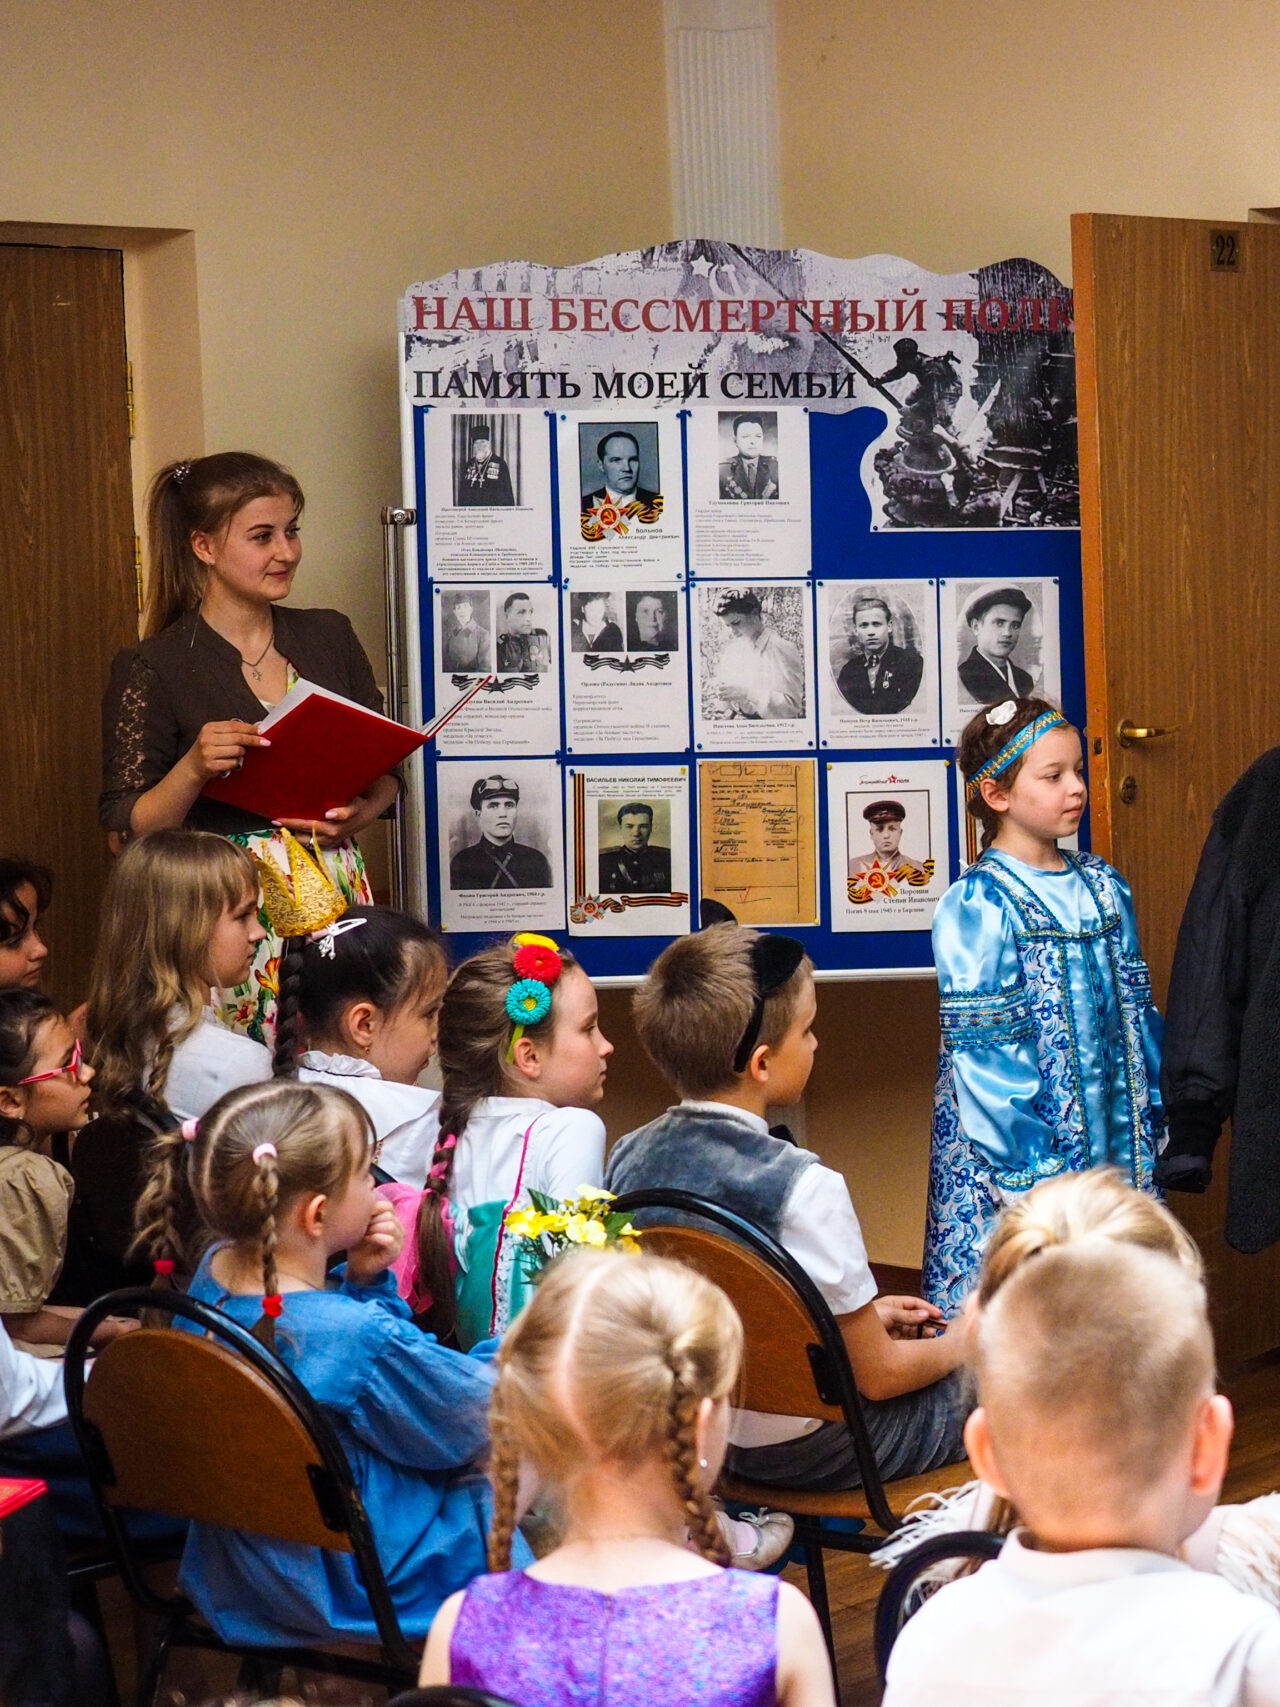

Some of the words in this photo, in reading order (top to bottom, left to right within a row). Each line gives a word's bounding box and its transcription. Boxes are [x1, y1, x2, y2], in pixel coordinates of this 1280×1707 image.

[1215, 234, 1236, 266] 22
[411, 296, 533, 331] НАШ
[548, 288, 927, 332] БЕССМЕРТНЫЙ
[942, 298, 1074, 332] ПОЛК
[413, 370, 581, 399] ПАМЯТЬ
[592, 363, 710, 399] МОЕЙ
[720, 371, 857, 400] СЕМЬИ
[900, 888, 929, 896] Воронин
